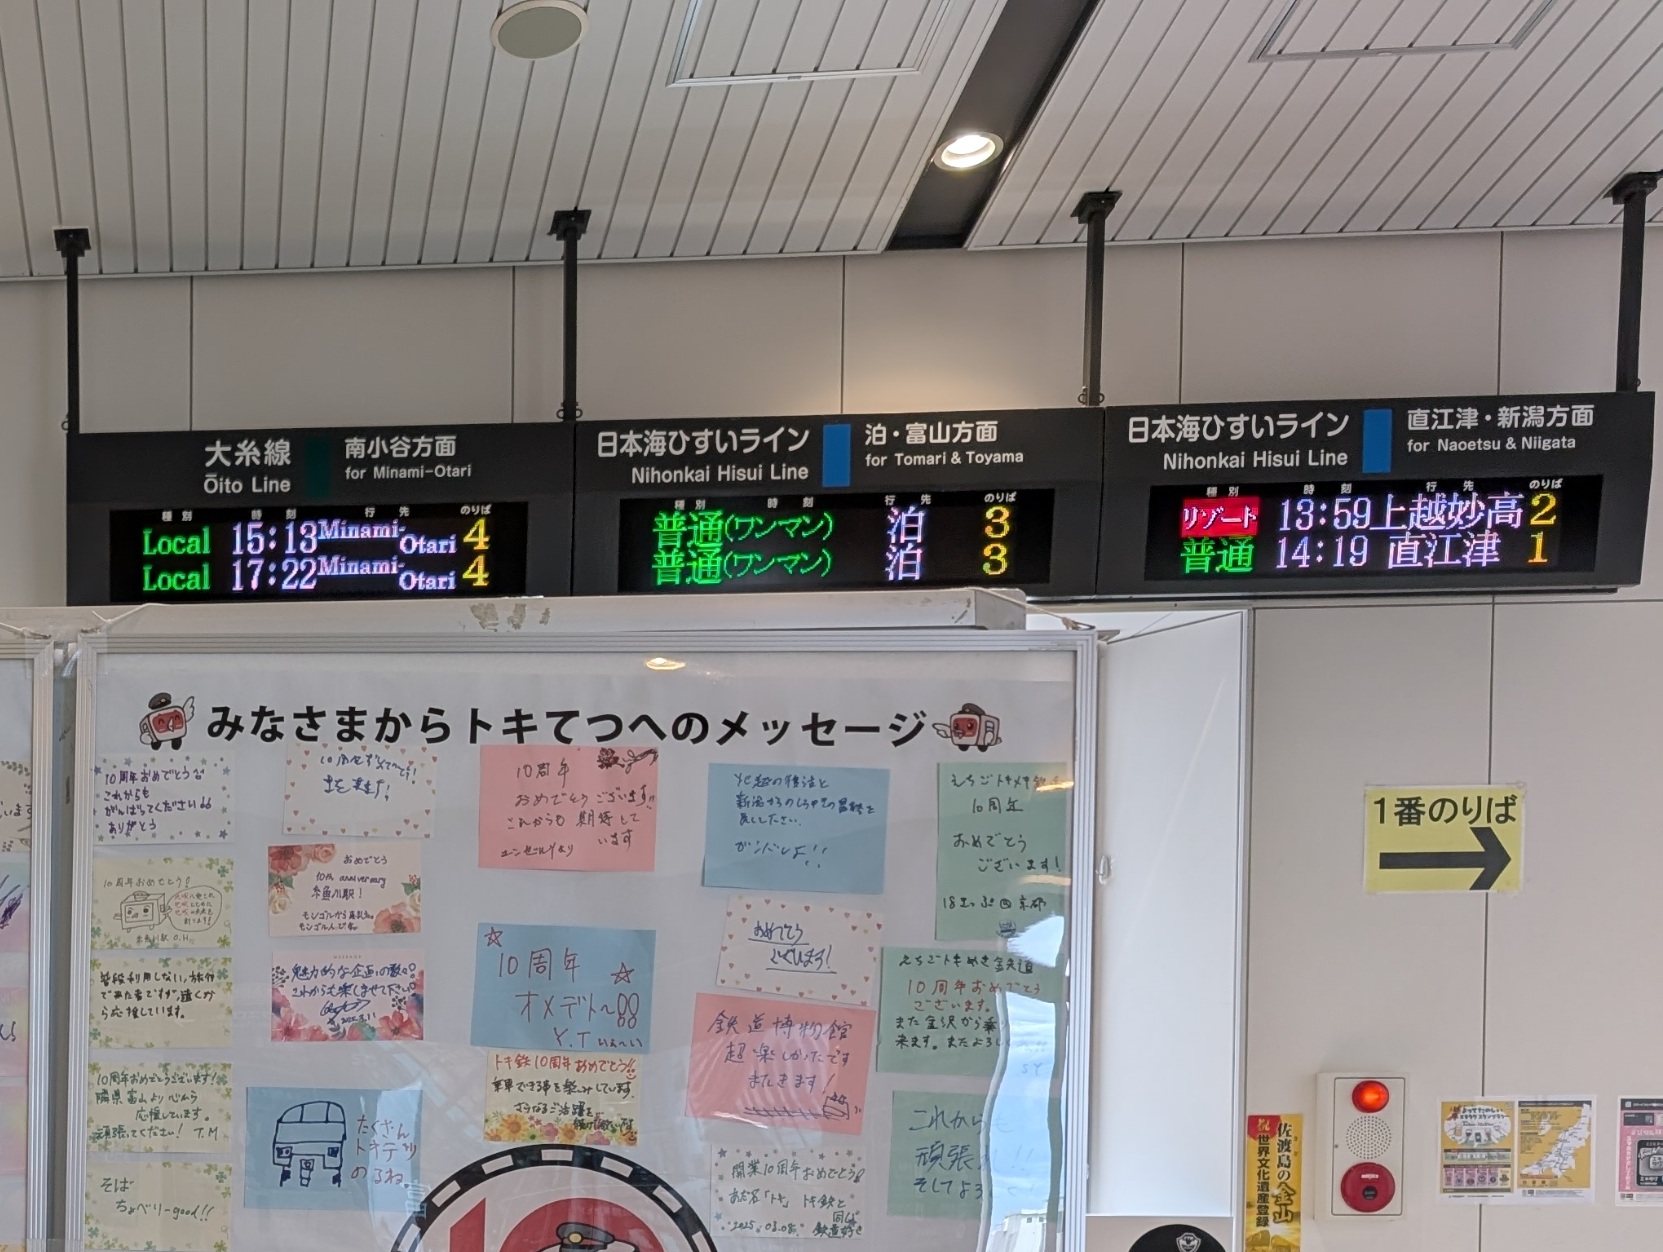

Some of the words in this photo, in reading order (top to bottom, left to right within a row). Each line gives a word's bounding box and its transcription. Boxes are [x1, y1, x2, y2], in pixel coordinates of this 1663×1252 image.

[1128, 412, 1350, 444] 日本海ひすいライン
[1407, 404, 1595, 431] 直江津・新潟方面
[345, 435, 457, 459] 南小谷方面
[596, 428, 810, 458] 日本海ひすいライン
[864, 420, 999, 446] 泊・富山方面
[1407, 438, 1430, 453] for
[1438, 436, 1501, 452] Naoetsu
[1505, 436, 1518, 450] &
[1521, 435, 1576, 452] Niigata
[205, 438, 291, 468] 大糸線
[864, 452, 887, 467] for
[894, 451, 947, 467] Tomari
[951, 451, 961, 465] &
[966, 450, 1024, 467] Toyama
[1163, 451, 1246, 471] Nihonkai
[1253, 450, 1301, 469] Hisui
[1308, 449, 1349, 467] Line
[252, 476, 291, 493] Line
[345, 466, 366, 480] for
[373, 465, 472, 480] Minami-Otari
[631, 466, 710, 485] Nihonkai
[717, 464, 763, 482] Hisui
[770, 463, 809, 481] Line
[1529, 478, 1563, 490] のりば
[460, 503, 491, 516] のりば
[984, 491, 1016, 503] のりば
[1182, 506, 1259, 531] リゾート
[1279, 498, 1372, 532] 13:59
[1369, 492, 1524, 531] 上越妙高
[1529, 492, 1558, 526] 2
[142, 526, 211, 555] Local
[232, 520, 318, 555] 15:13
[398, 533, 457, 554] Otari
[463, 518, 490, 550] 4
[886, 506, 925, 545] 泊
[984, 506, 1010, 539] 3
[885, 543, 924, 581] 泊
[983, 544, 1009, 576] 3
[1181, 536, 1255, 574] 普通
[1276, 534, 1369, 569] 14:19
[1388, 529, 1502, 569] 直江津
[1528, 531, 1548, 563] 1
[142, 562, 211, 591] Local
[232, 557, 318, 591] 17:22
[398, 570, 457, 591] Otari
[462, 555, 490, 587] 4
[207, 705, 927, 747] みなさまからトキてつへのメッセージ
[1373, 794, 1517, 826] 1番のりば
[498, 947, 581, 983] 10周年
[1256, 1134, 1270, 1228] 世界文化遺産登録
[1271, 1122, 1296, 1224] 佐渡島の金山
